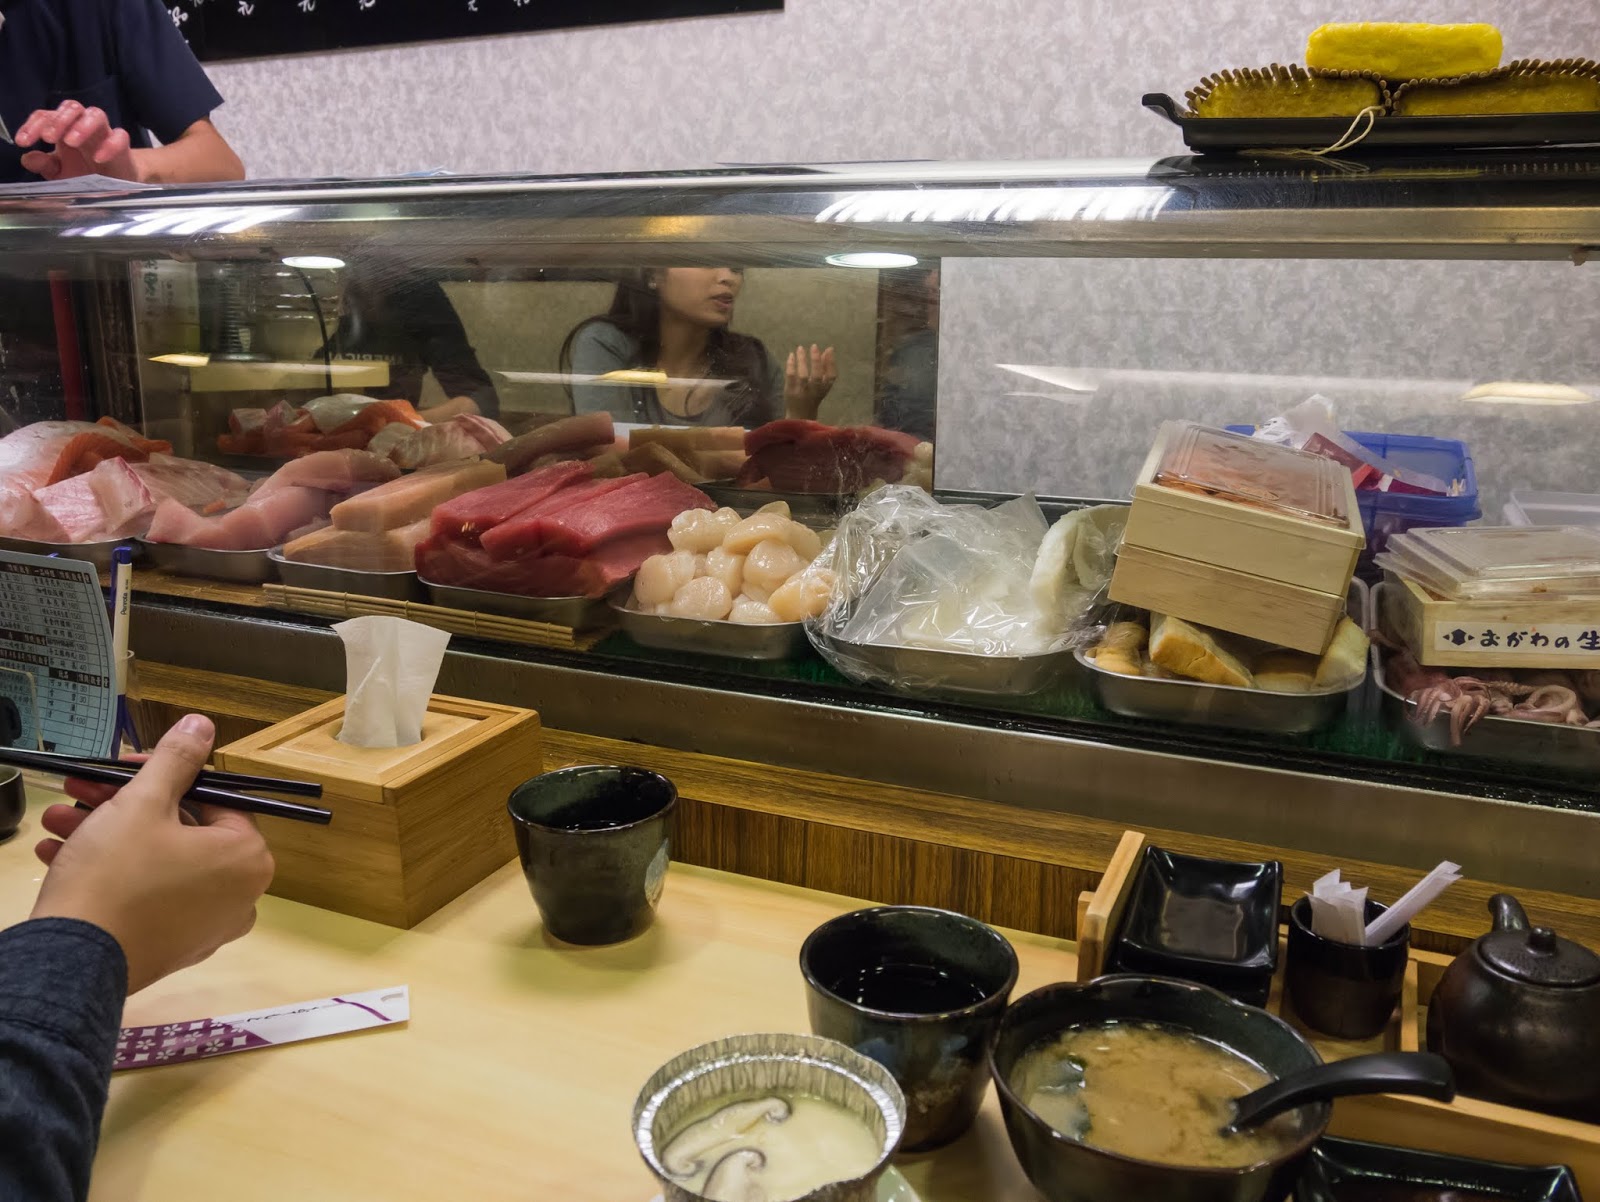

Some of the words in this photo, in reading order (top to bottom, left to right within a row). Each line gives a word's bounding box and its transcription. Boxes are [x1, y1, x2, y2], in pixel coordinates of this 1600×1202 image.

[1480, 629, 1600, 651] おがわの生
